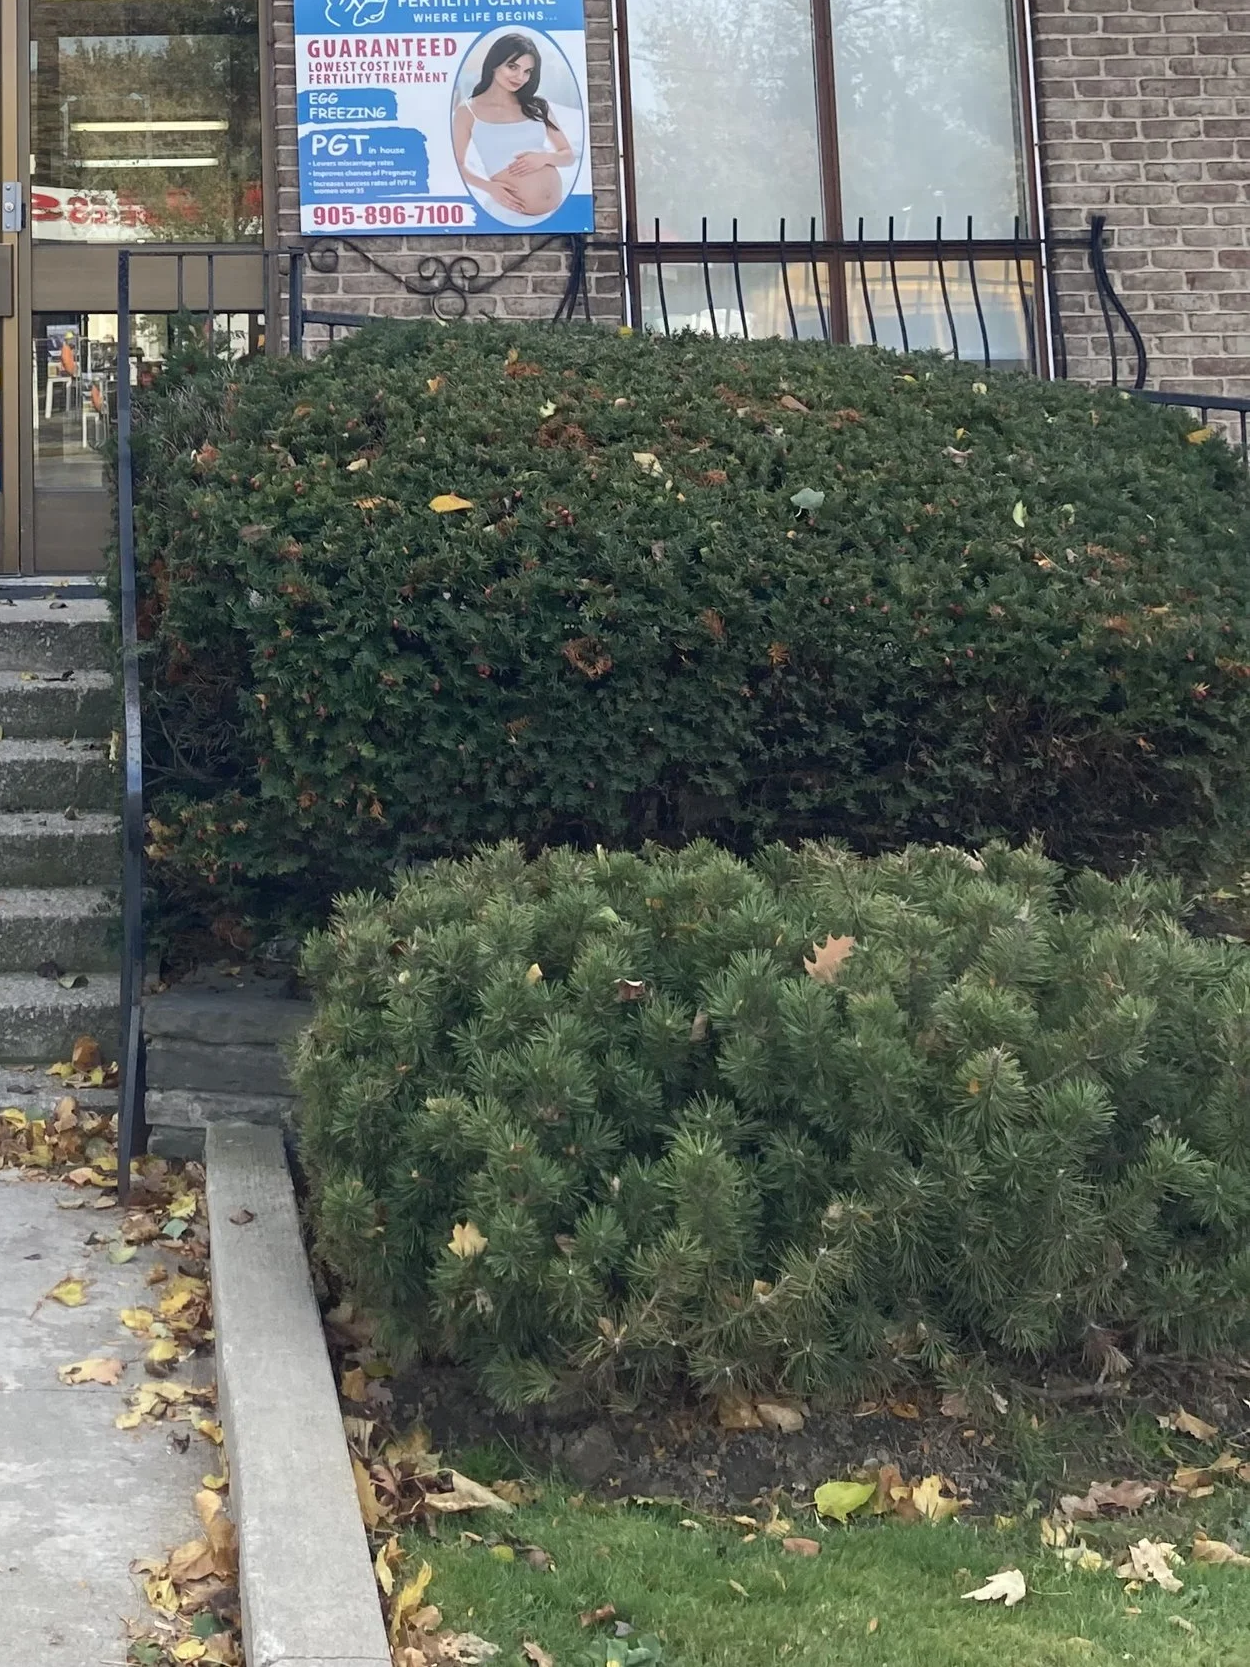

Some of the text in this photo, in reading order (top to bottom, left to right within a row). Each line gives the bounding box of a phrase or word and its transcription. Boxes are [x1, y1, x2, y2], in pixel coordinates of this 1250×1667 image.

[413, 13, 458, 23] WHERE
[463, 12, 491, 23] LIFE
[307, 38, 457, 58] GUARANTEED
[309, 60, 425, 72] LOWEST COST IVF &
[309, 72, 448, 84] FERTILITY TREATMENT
[309, 93, 338, 104] EGG
[309, 107, 387, 120] FREEZING
[312, 134, 370, 156] PGT
[313, 205, 463, 225] 905-896-7100
